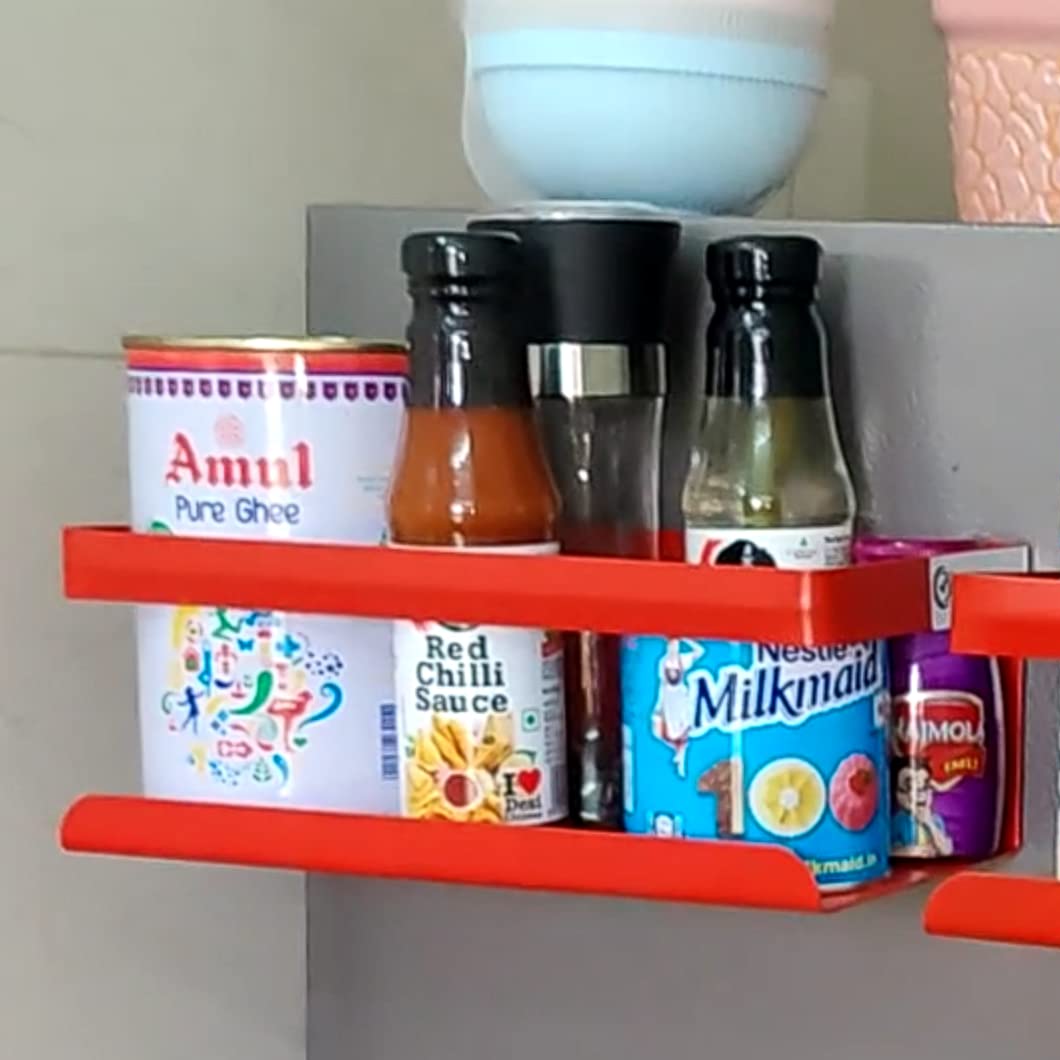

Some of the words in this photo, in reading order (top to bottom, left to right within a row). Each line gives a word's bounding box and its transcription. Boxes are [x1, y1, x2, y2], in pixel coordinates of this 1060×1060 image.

[165, 431, 313, 489] Amul
[175, 495, 226, 523] Pure
[235, 497, 300, 525] Ghee
[425, 634, 489, 660] Red
[416, 661, 505, 688] Chilli
[694, 640, 879, 728] Milkmaid
[415, 687, 510, 714] Sauce
[503, 773, 516, 797] I
[808, 853, 878, 876] kmaid.in
